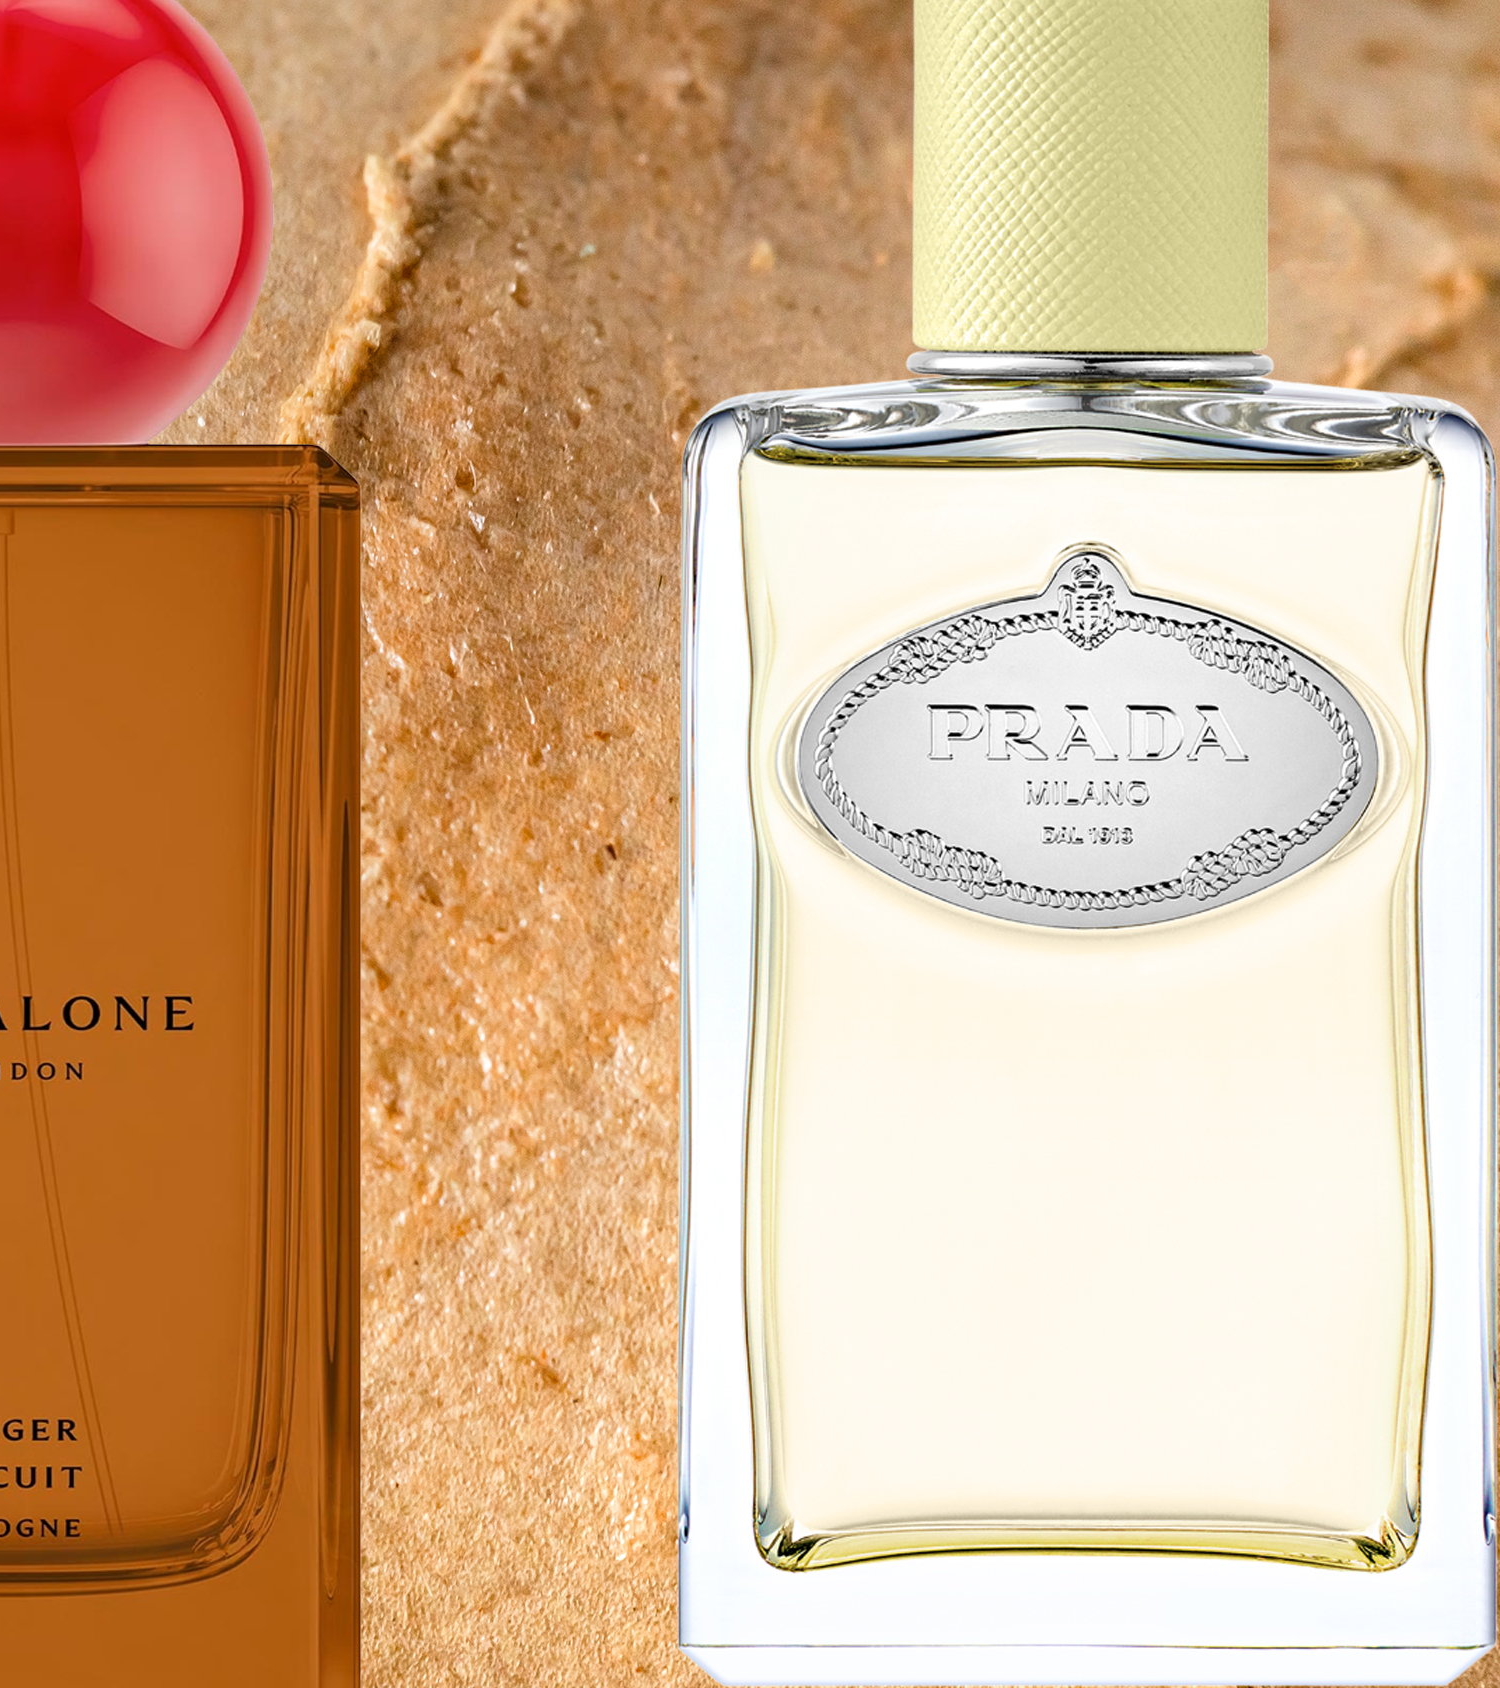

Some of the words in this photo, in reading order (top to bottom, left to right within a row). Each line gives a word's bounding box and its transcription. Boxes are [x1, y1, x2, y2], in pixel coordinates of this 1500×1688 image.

[926, 704, 1249, 761] PRADA
[1024, 780, 1150, 806] MILANO
[1041, 826, 1084, 844] DAL
[1088, 826, 1134, 845] 1913
